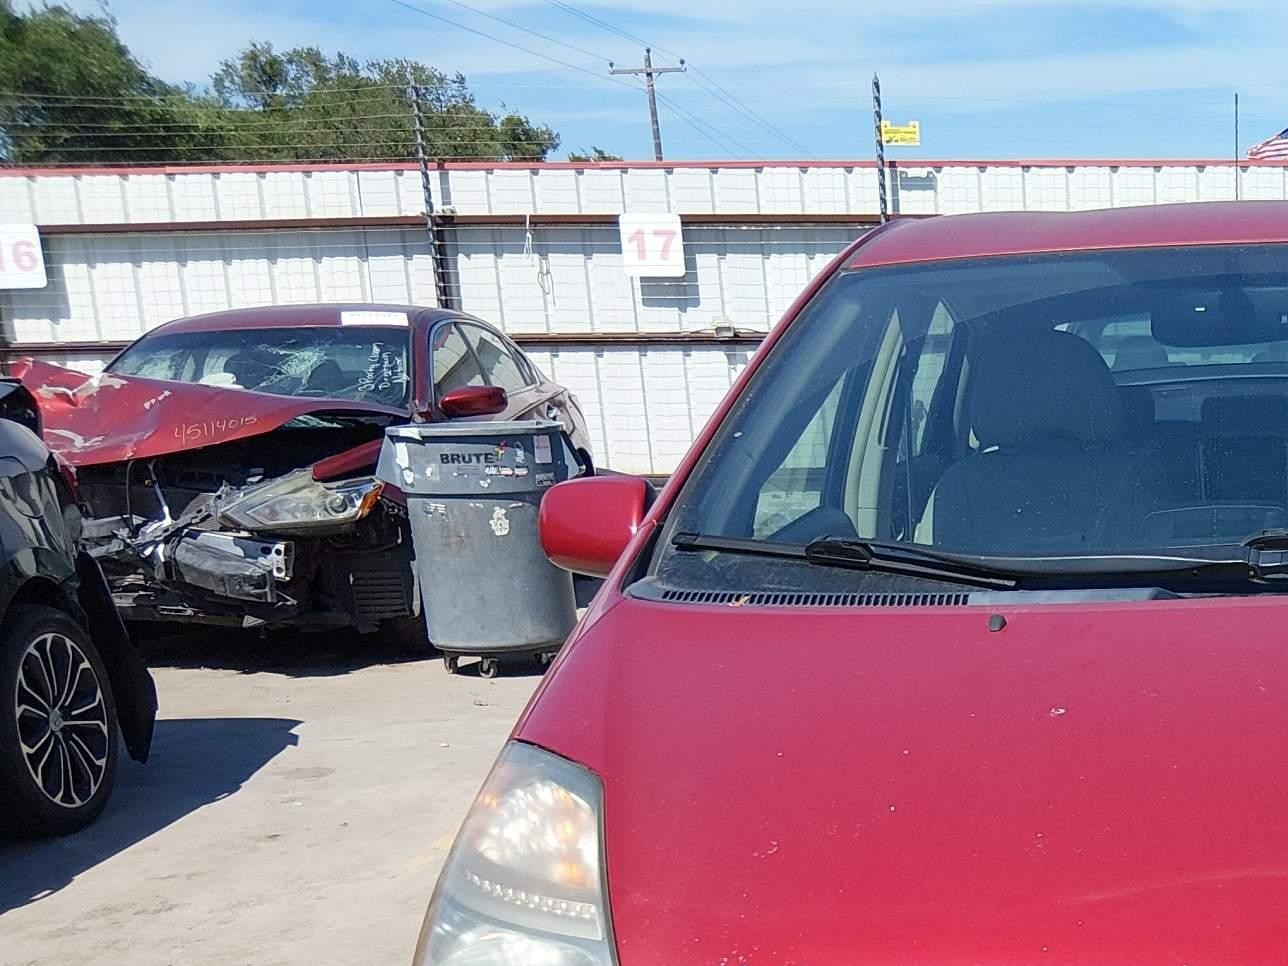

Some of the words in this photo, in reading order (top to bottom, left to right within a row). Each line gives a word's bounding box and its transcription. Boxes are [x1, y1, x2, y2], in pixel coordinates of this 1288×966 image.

[628, 229, 676, 260] 17
[174, 415, 258, 446] 45114015
[440, 452, 494, 464] BRUTE
